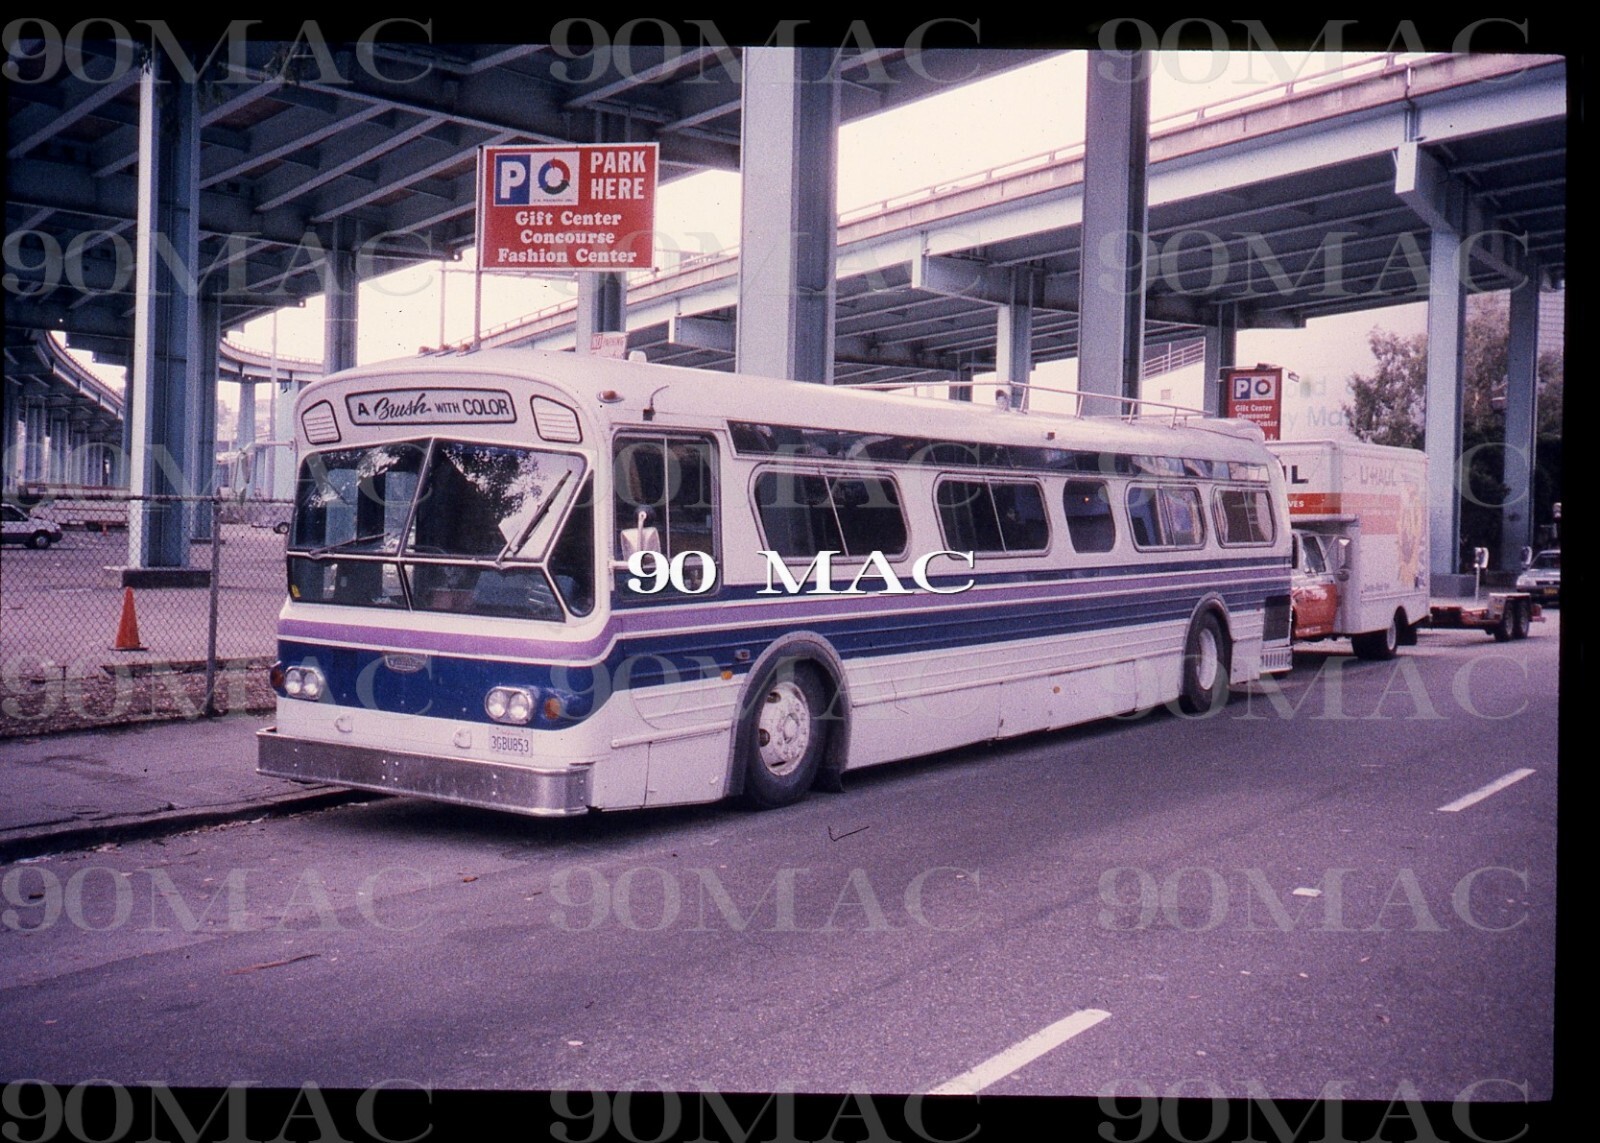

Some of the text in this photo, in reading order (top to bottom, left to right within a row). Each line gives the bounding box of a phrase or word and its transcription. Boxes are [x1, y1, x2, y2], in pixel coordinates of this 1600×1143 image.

[590, 151, 647, 173] PARK
[591, 178, 645, 199] HERE
[515, 211, 622, 226] Gift Center
[520, 229, 615, 244] Concourse
[498, 248, 637, 263] Fashion Center
[357, 393, 510, 420] A Brush WITH COLOR
[1250, 404, 1272, 412] Center
